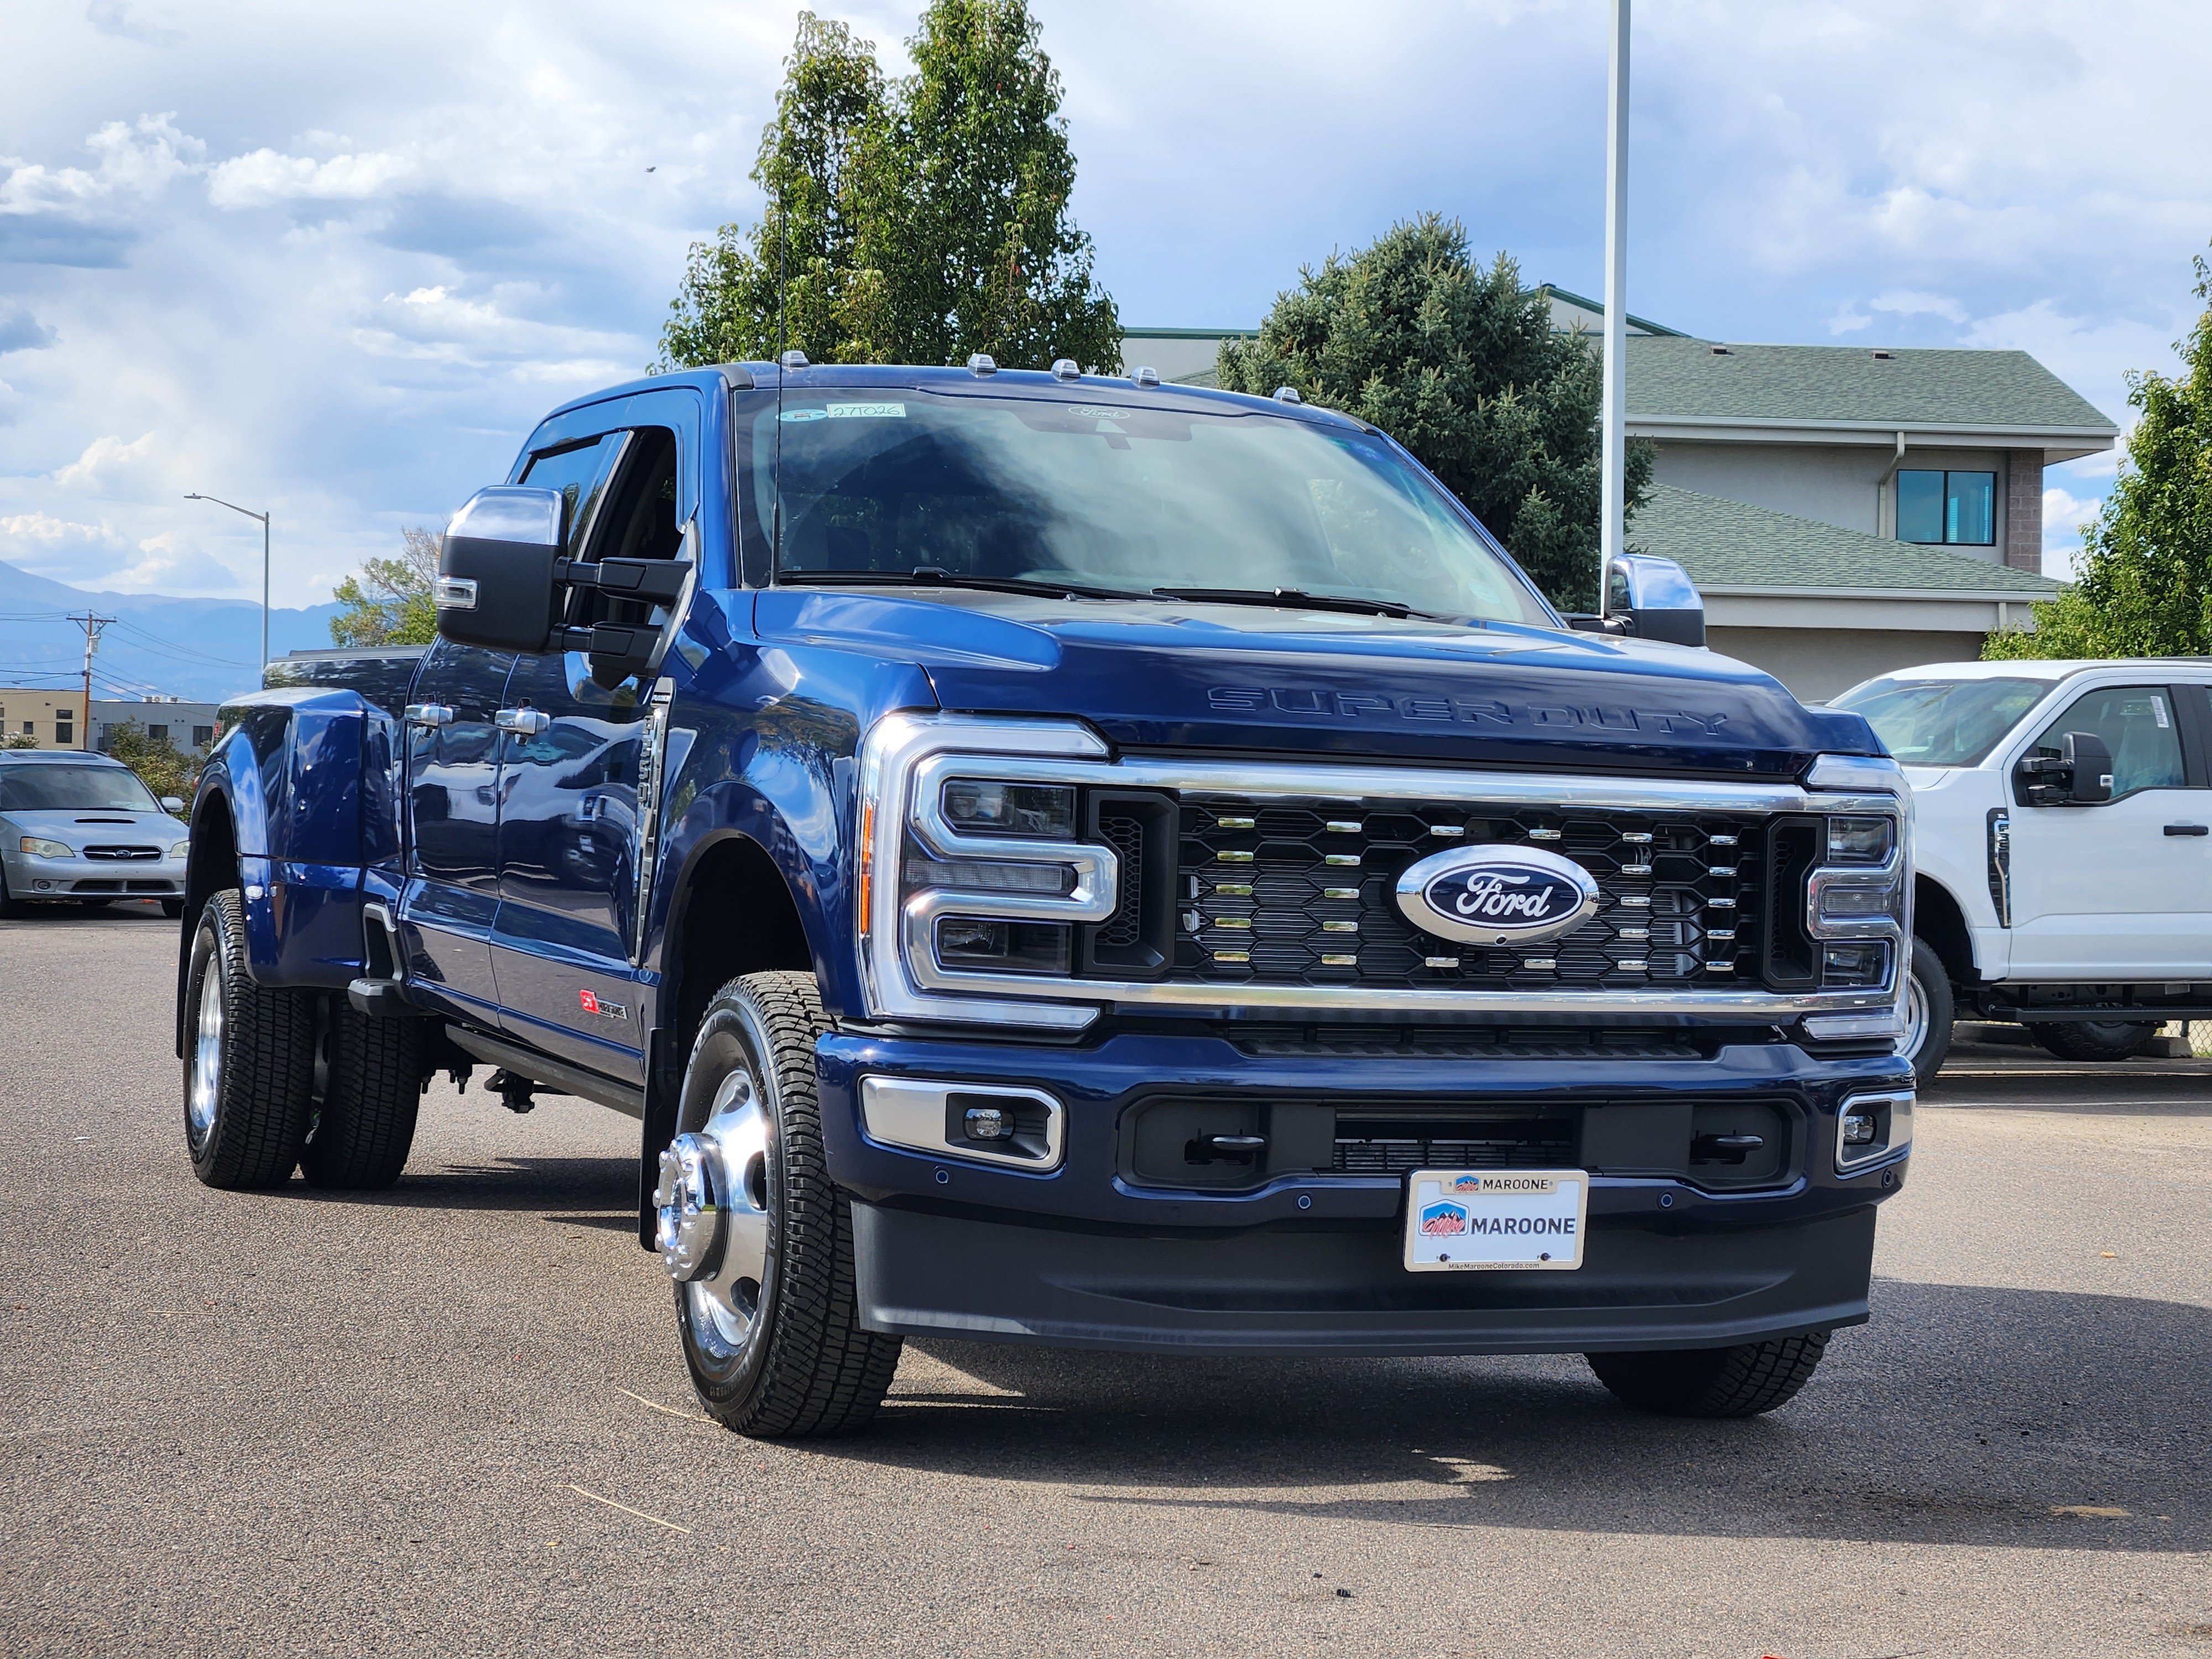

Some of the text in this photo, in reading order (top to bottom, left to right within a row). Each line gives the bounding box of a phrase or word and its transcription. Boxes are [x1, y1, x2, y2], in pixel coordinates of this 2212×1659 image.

[1207, 686, 1728, 736] SUPER DUTY
[1456, 872, 1554, 917] Ford
[1483, 1179, 1548, 1190] MAROONE
[1422, 1216, 1576, 1240] Mike MAROONE
